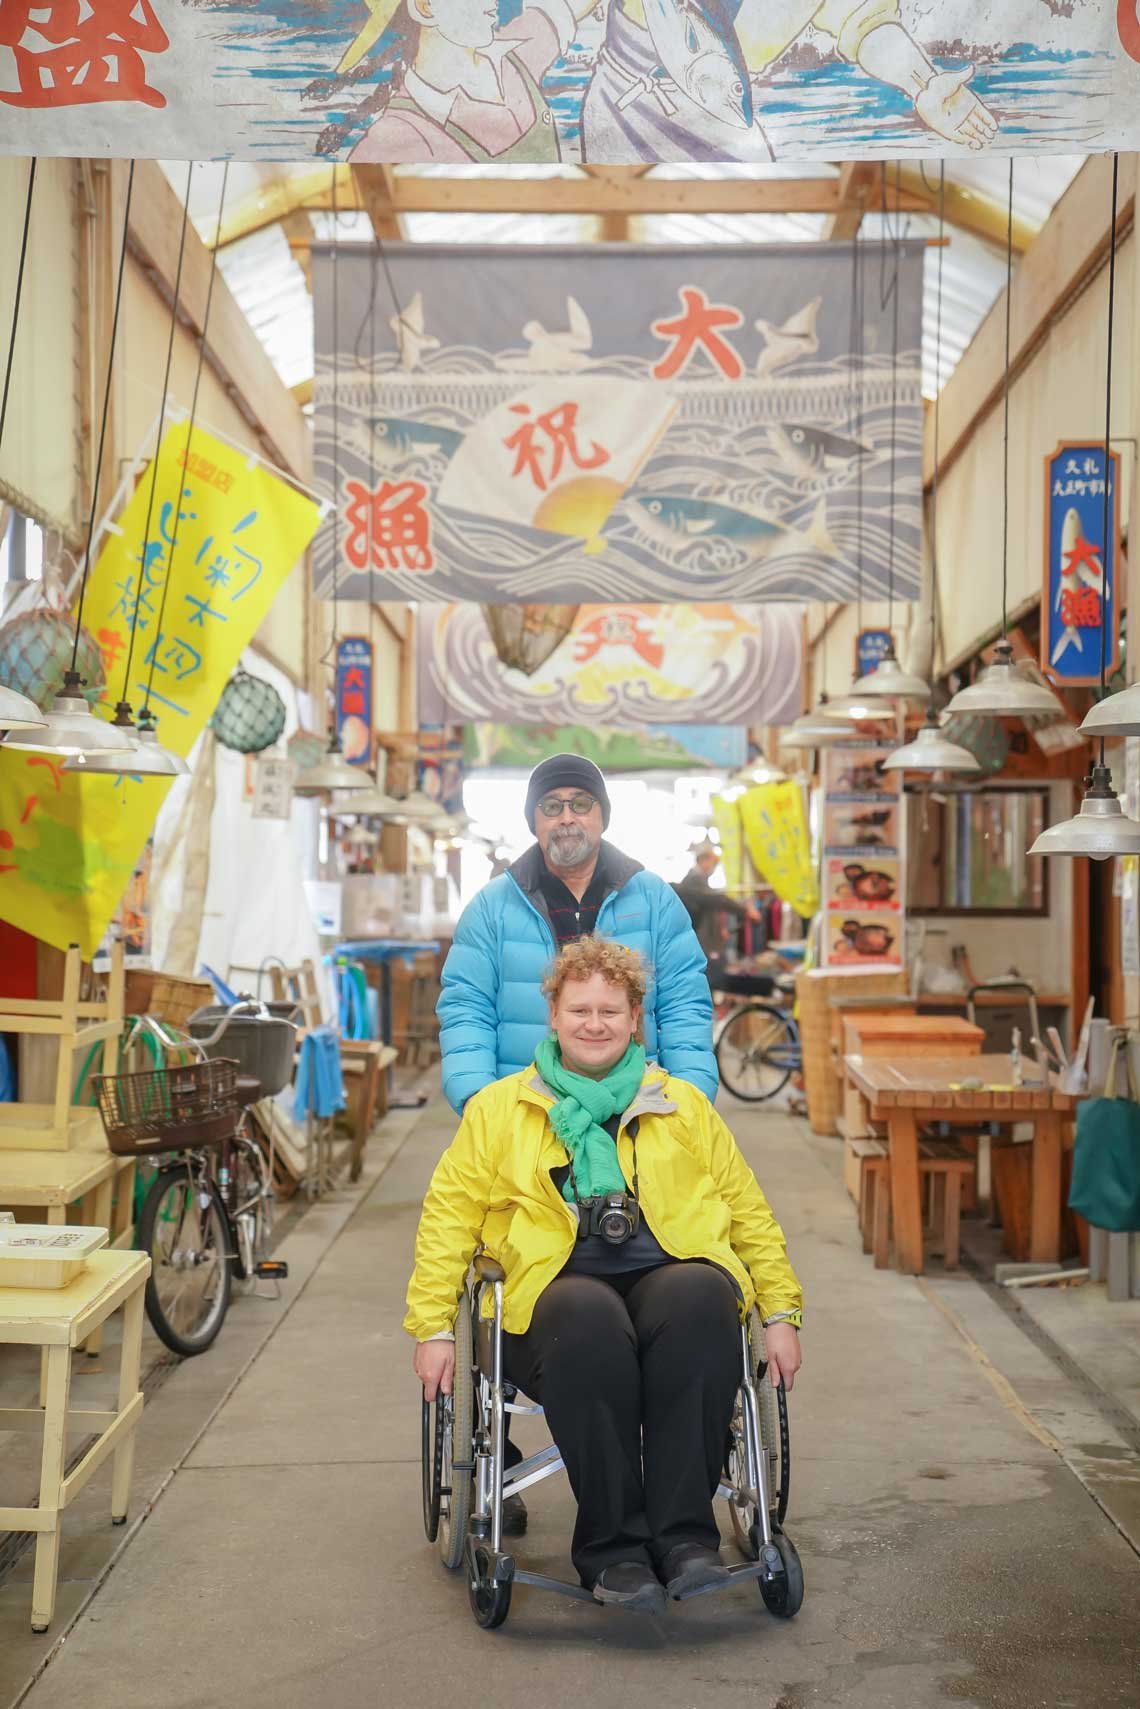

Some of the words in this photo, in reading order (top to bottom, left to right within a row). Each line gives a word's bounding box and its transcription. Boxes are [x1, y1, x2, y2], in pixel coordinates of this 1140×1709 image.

[650, 285, 745, 380] 大
[502, 402, 611, 491] 祝
[343, 480, 434, 572] 漁
[1061, 536, 1102, 626] 大漁
